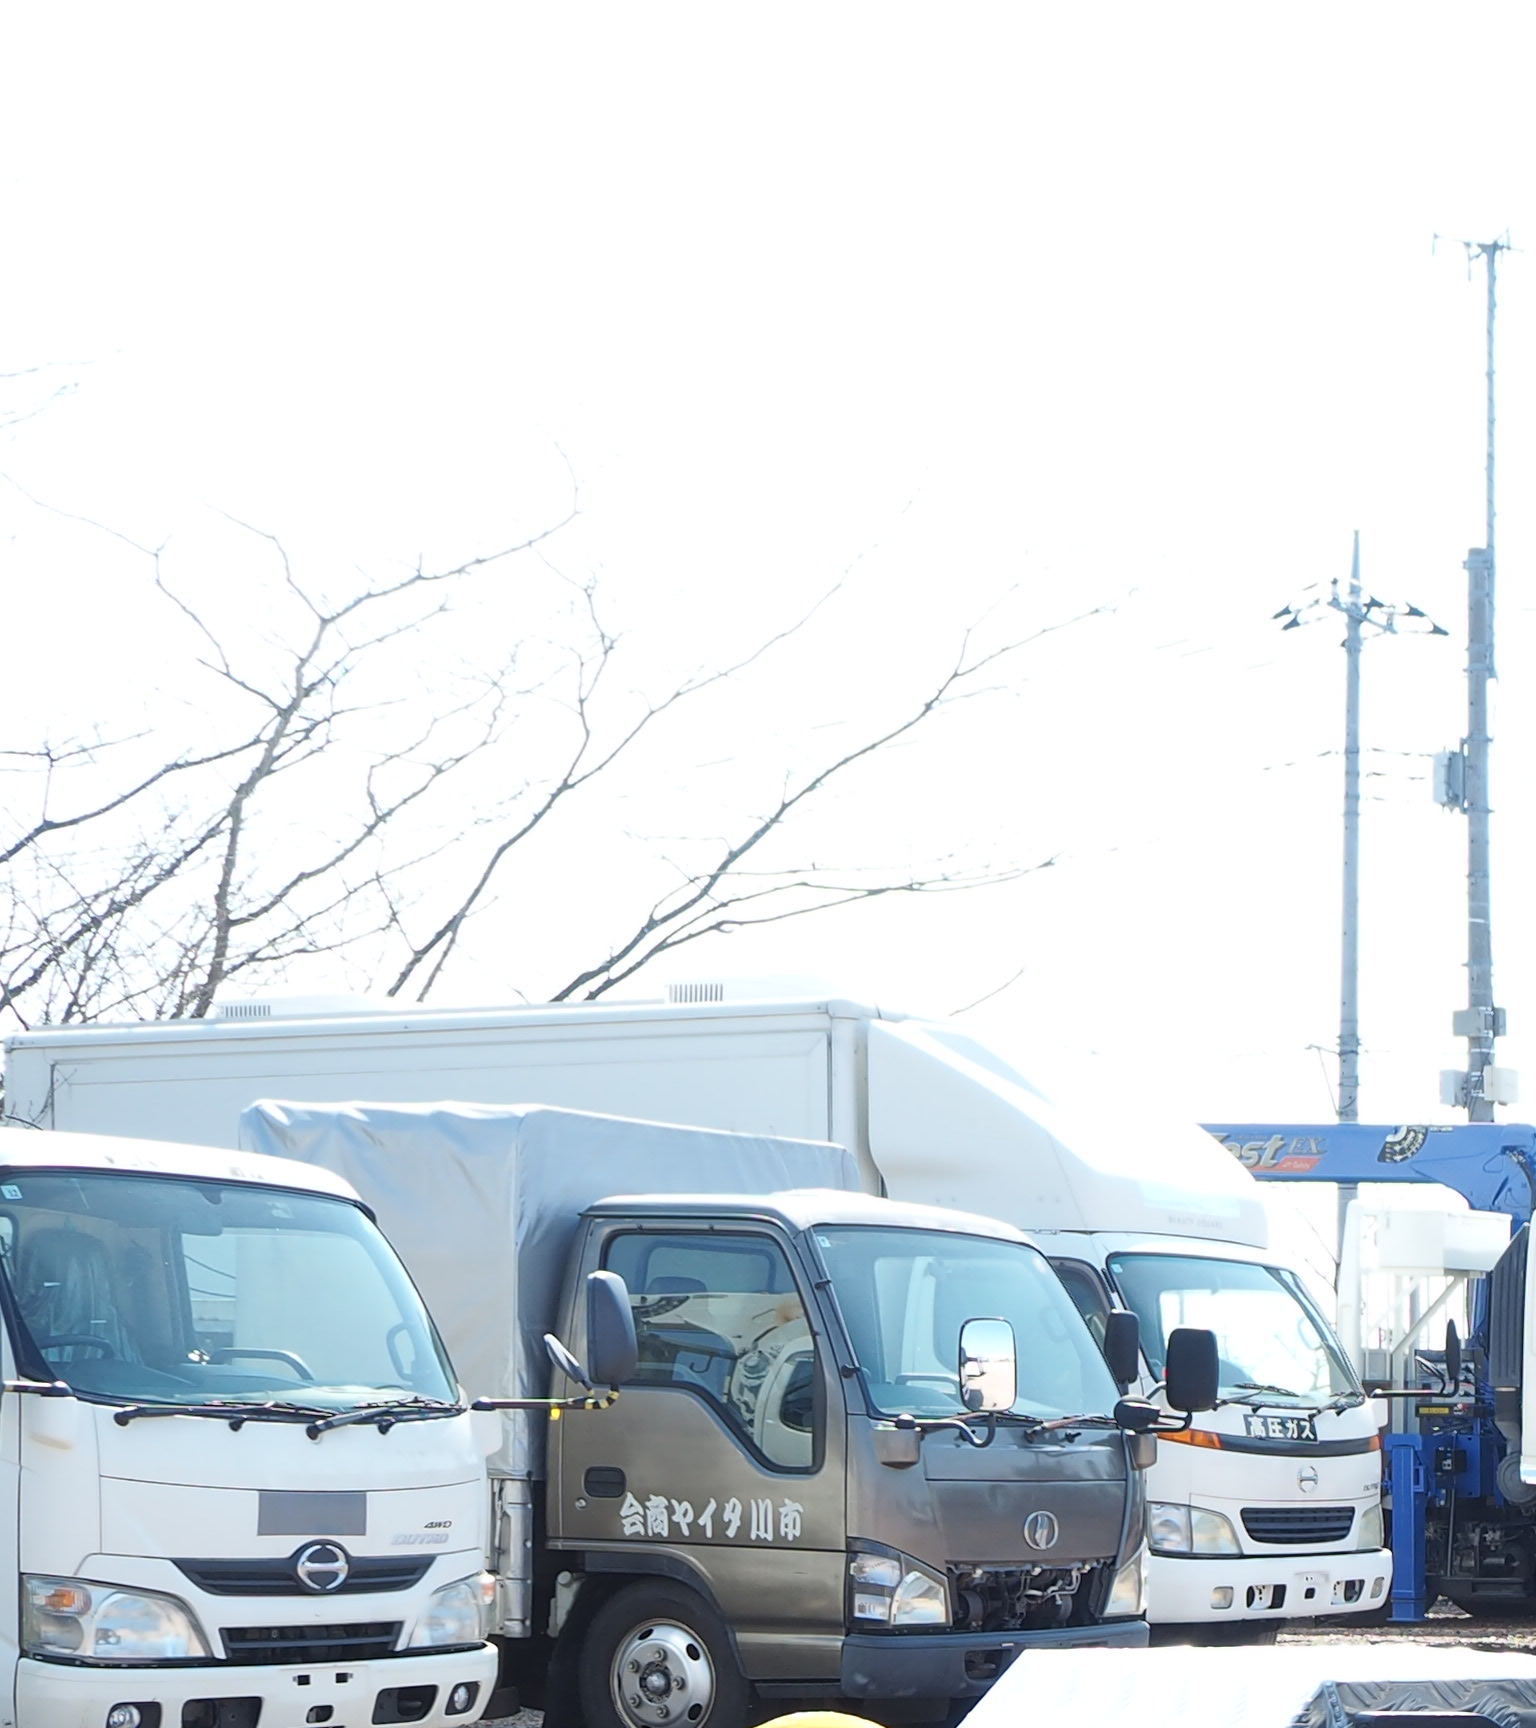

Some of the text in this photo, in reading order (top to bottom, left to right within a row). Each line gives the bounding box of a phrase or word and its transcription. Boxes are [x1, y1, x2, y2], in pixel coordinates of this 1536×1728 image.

[1248, 1416, 1316, 1441] 高圧ガス
[423, 1519, 453, 1529] 4WD
